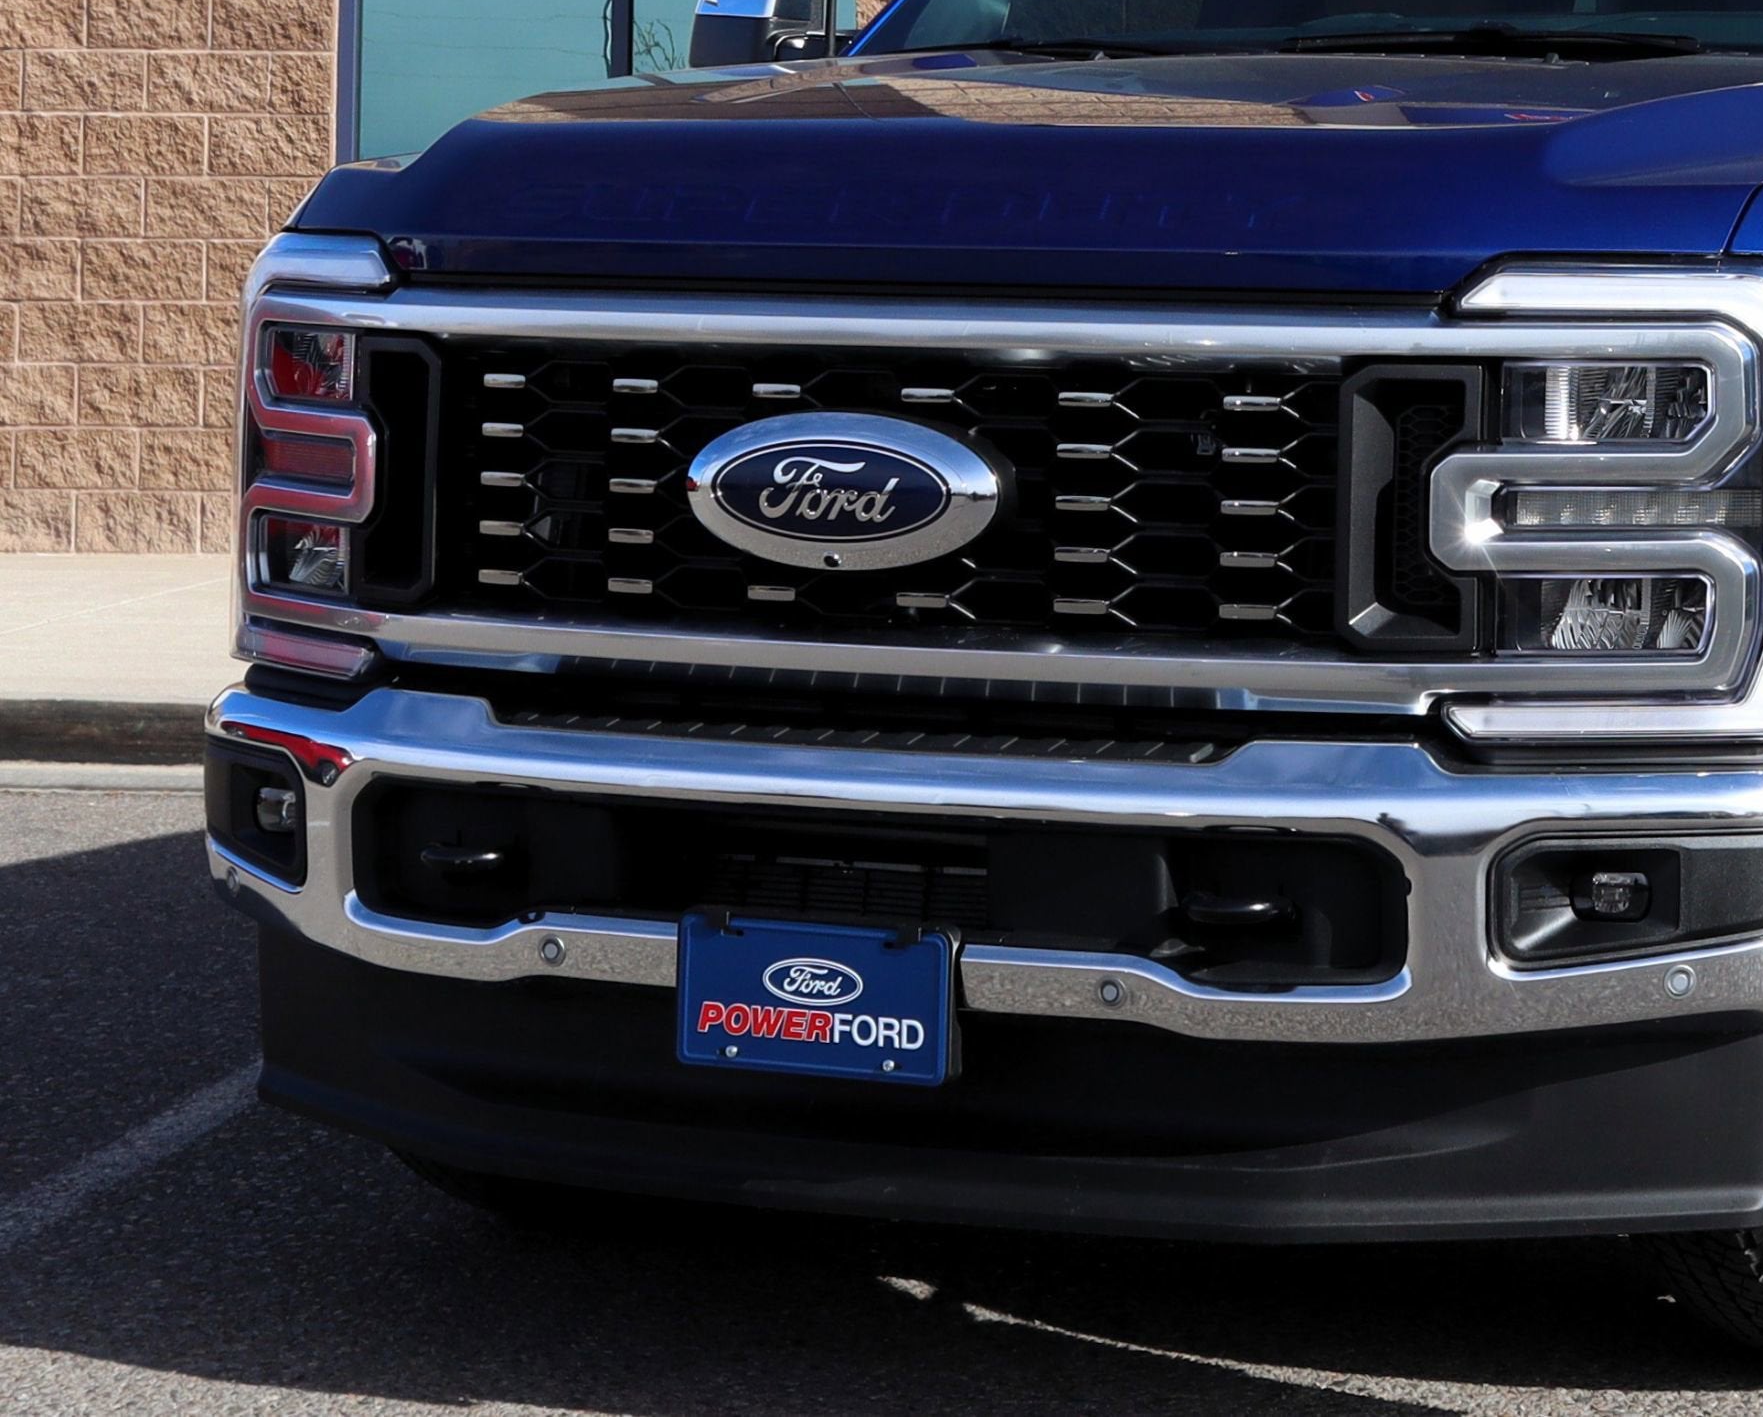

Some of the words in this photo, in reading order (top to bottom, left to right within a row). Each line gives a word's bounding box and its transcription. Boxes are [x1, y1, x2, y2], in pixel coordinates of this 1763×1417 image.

[758, 456, 900, 523] Ford
[783, 966, 842, 997] Ford
[697, 1000, 925, 1051] POWERFORD
